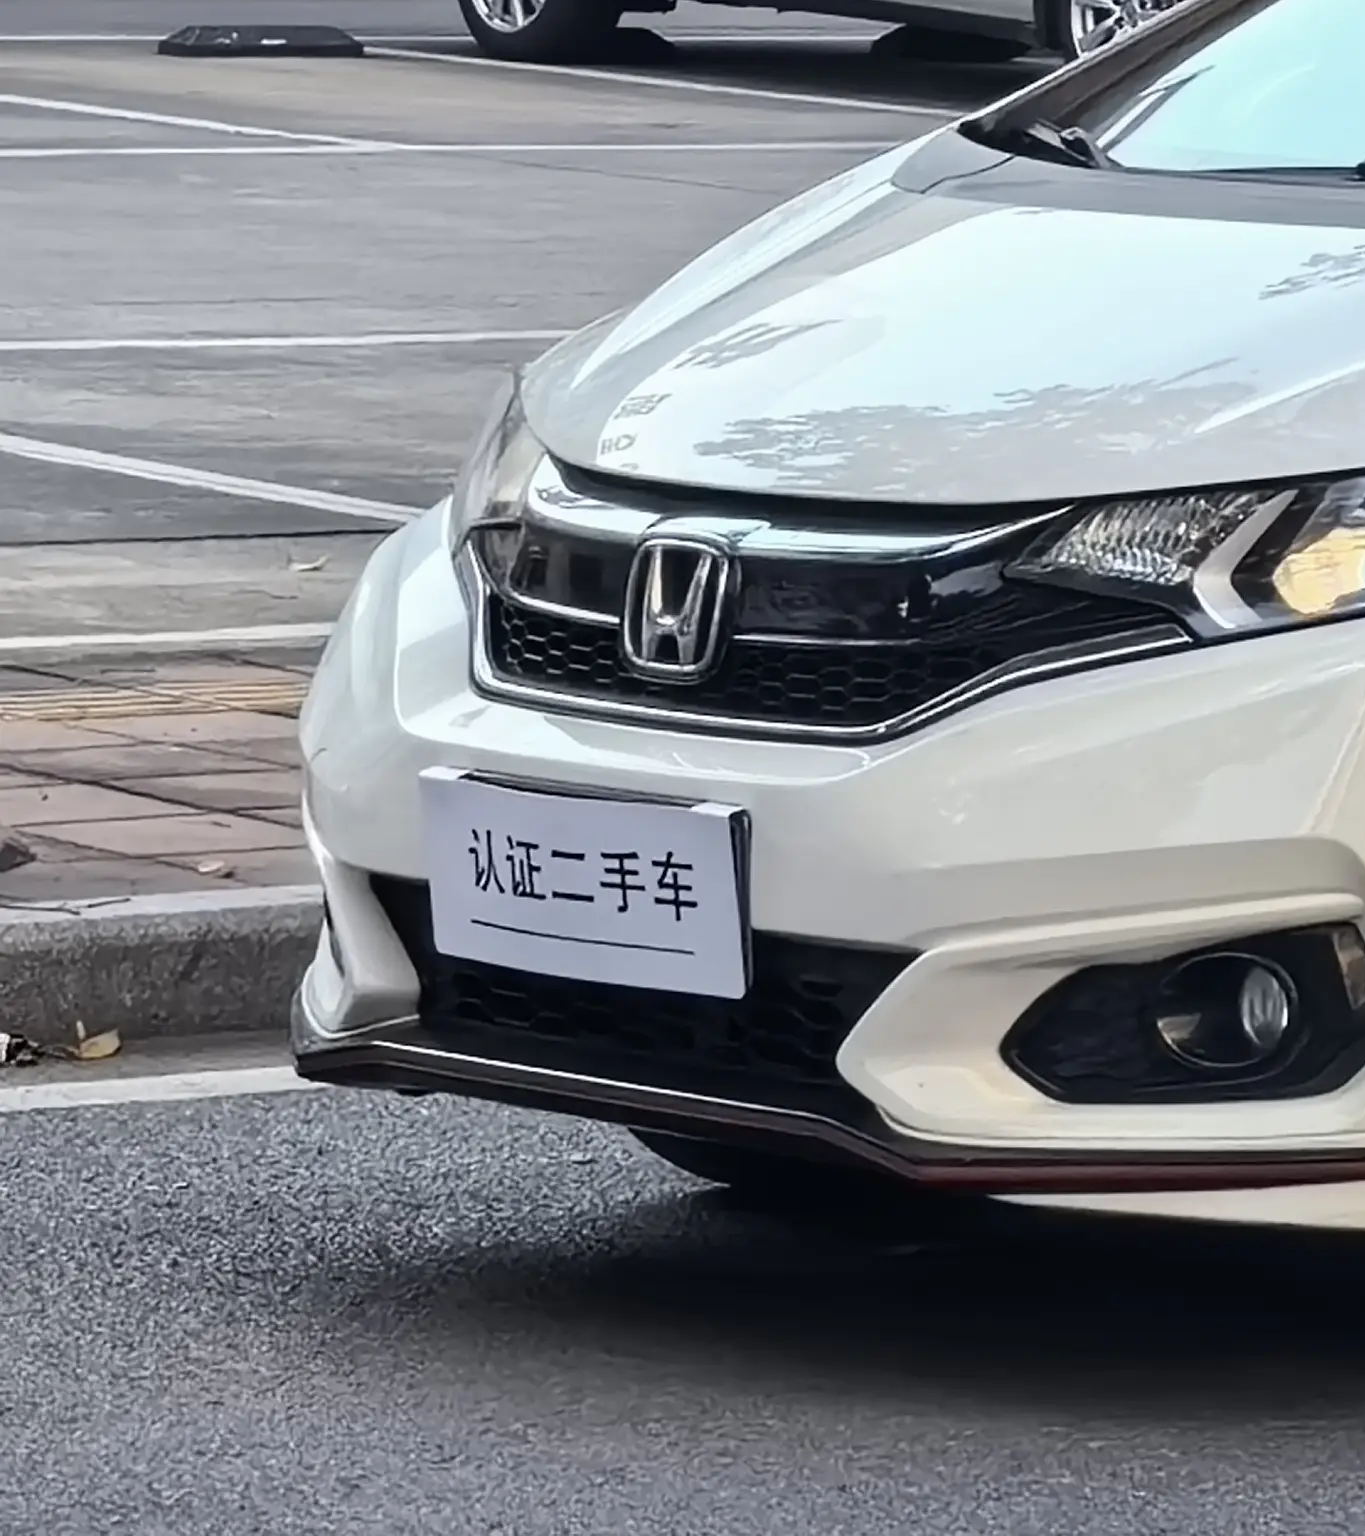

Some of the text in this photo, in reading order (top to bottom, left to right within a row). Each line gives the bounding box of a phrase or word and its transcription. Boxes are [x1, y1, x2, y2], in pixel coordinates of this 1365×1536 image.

[468, 828, 698, 922] 认证二手车
